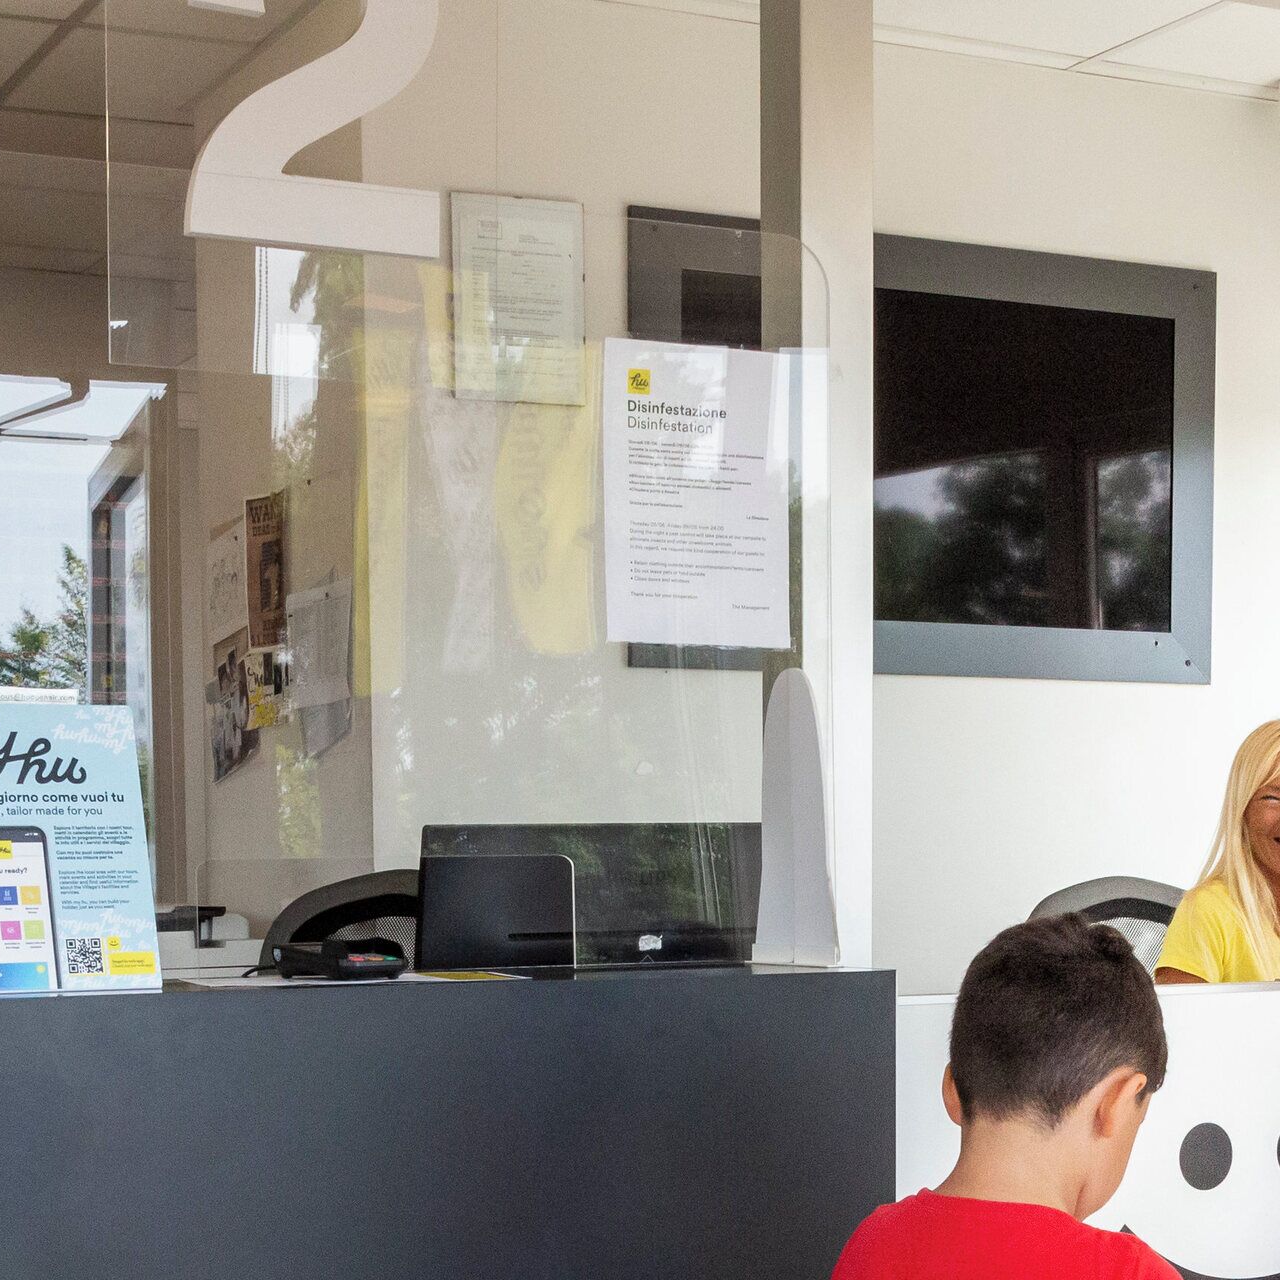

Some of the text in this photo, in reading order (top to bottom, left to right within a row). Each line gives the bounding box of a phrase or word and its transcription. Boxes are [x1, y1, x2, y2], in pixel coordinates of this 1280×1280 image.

[184, 0, 440, 256] 2
[628, 400, 726, 419] Disinfestazione
[628, 416, 712, 434] Disinfestation
[42, 794, 78, 803] come
[78, 792, 108, 802] vuoi
[111, 792, 124, 802] tu
[6, 806, 33, 816] tailor
[36, 806, 64, 816] made
[68, 806, 82, 816] for
[84, 808, 103, 818] you
[4, 866, 28, 875] ready?
